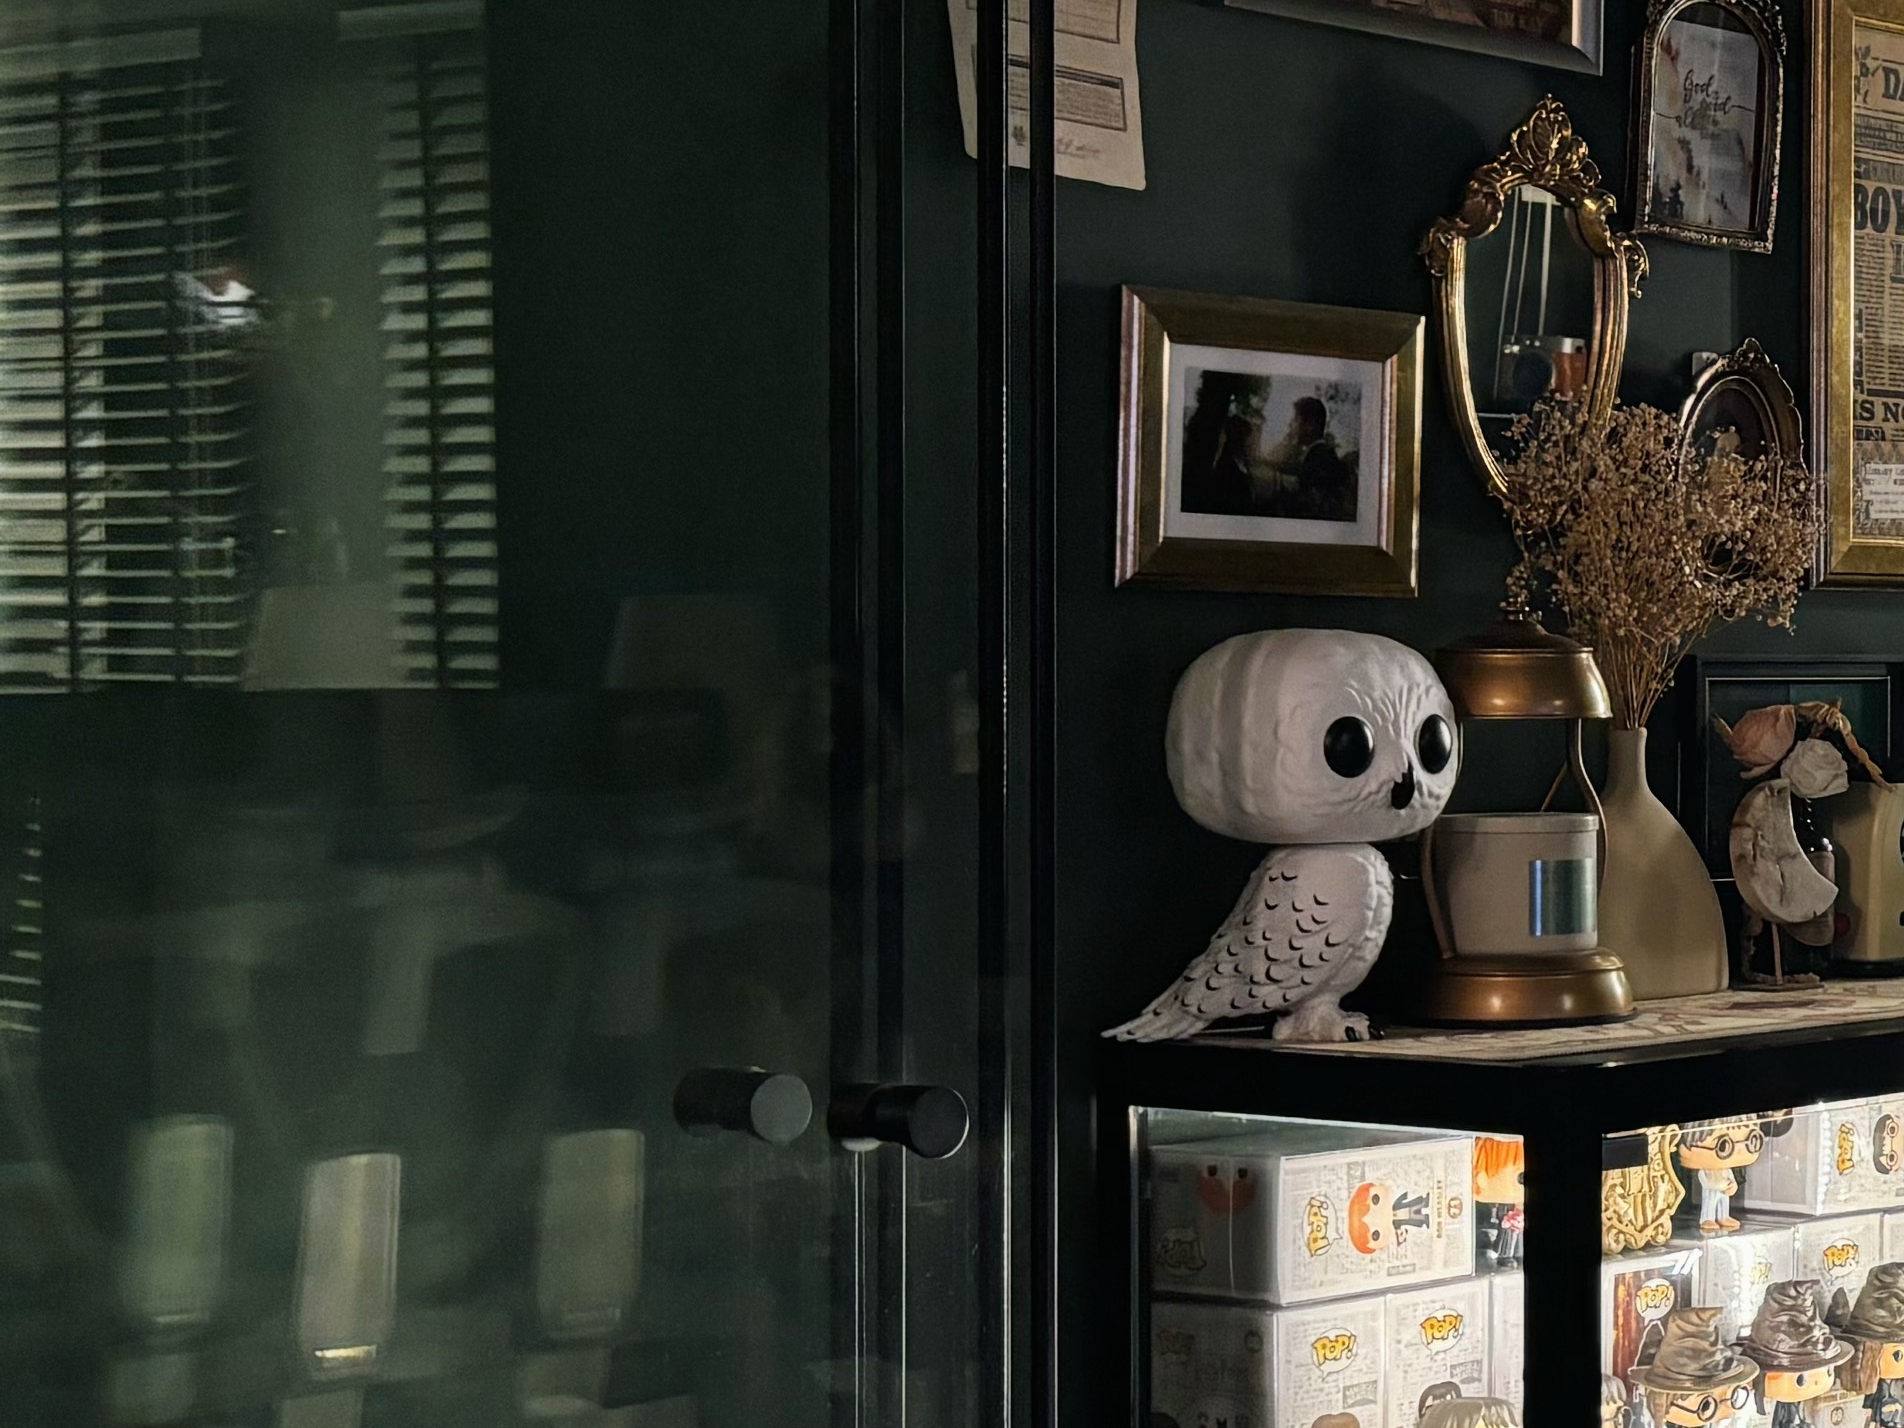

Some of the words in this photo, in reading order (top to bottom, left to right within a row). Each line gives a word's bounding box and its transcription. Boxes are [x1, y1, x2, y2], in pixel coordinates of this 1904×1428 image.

[1853, 399, 1875, 422] IS
[1306, 1196, 1331, 1258] POP!
[1636, 1284, 1674, 1311] POP!
[1420, 1314, 1463, 1346] POP!
[1312, 1334, 1357, 1367] POP!
